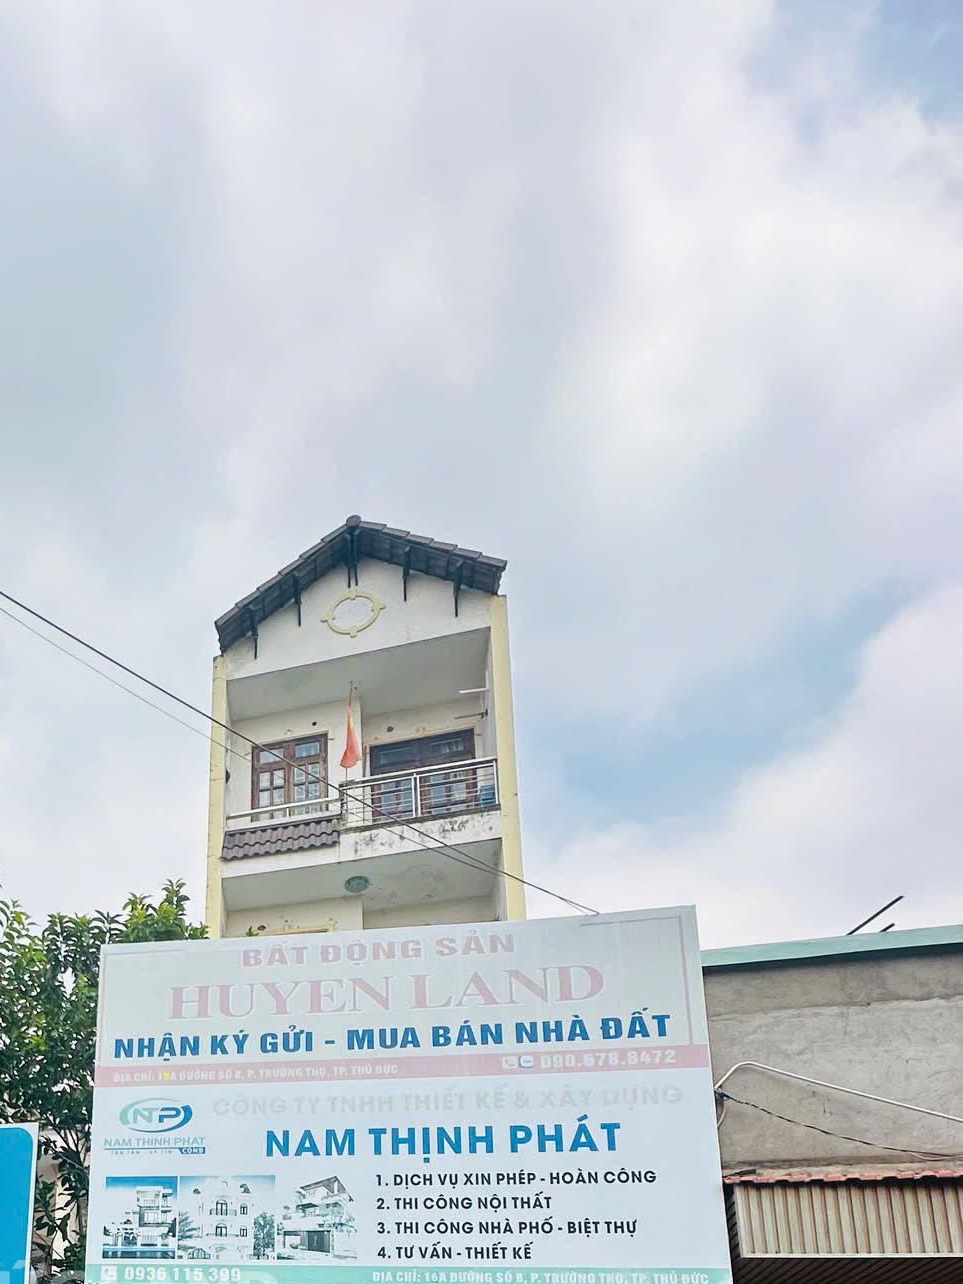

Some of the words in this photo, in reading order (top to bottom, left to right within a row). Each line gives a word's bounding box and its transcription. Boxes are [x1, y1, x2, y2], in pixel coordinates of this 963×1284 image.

[320, 938, 422, 966] ĐỘNG
[436, 929, 515, 958] SẢN
[408, 965, 604, 1009] LAND
[114, 1033, 200, 1061] NHẬN
[210, 1029, 249, 1055] KÝ
[260, 1024, 313, 1054] GỬI
[347, 1027, 421, 1050] MUA
[432, 1020, 503, 1048] BÁN
[515, 1014, 590, 1044] NHÀ
[600, 1007, 670, 1040] ĐẤT
[540, 1050, 678, 1068] 090.678.8472
[213, 1094, 287, 1116] CÔNG
[294, 1096, 320, 1114] TY
[266, 1129, 355, 1157] NAM
[369, 1126, 494, 1164] THỊNH
[509, 1114, 621, 1152] PHÁT
[376, 1174, 389, 1186] 1.
[394, 1173, 433, 1189] DỊCH
[438, 1173, 458, 1189] VỤ
[464, 1173, 491, 1185] XIN
[497, 1169, 536, 1185] PHÉP
[550, 1168, 598, 1184] HOÀN
[603, 1168, 657, 1184] CÔNG
[376, 1197, 390, 1210] 2.
[394, 1197, 418, 1209] THI
[423, 1194, 473, 1209] CÔNG
[478, 1193, 507, 1213] NỘI
[511, 1191, 552, 1209] THẤT
[377, 1222, 391, 1234] 3.
[395, 1222, 419, 1234] THI
[424, 1218, 474, 1234] CÔNG
[479, 1218, 514, 1234] NHÀ
[518, 1216, 554, 1234] PHỐ
[567, 1217, 600, 1237] BIỆT
[604, 1219, 637, 1237] THỰ
[377, 1246, 391, 1259] 4.
[396, 1245, 415, 1259] TƯ
[419, 1241, 452, 1259] VẤN
[465, 1241, 507, 1259] THIẾT
[513, 1241, 534, 1259] KẾ
[124, 1266, 167, 1280] 0936
[172, 1267, 203, 1281] 115
[208, 1267, 242, 1281] 399
